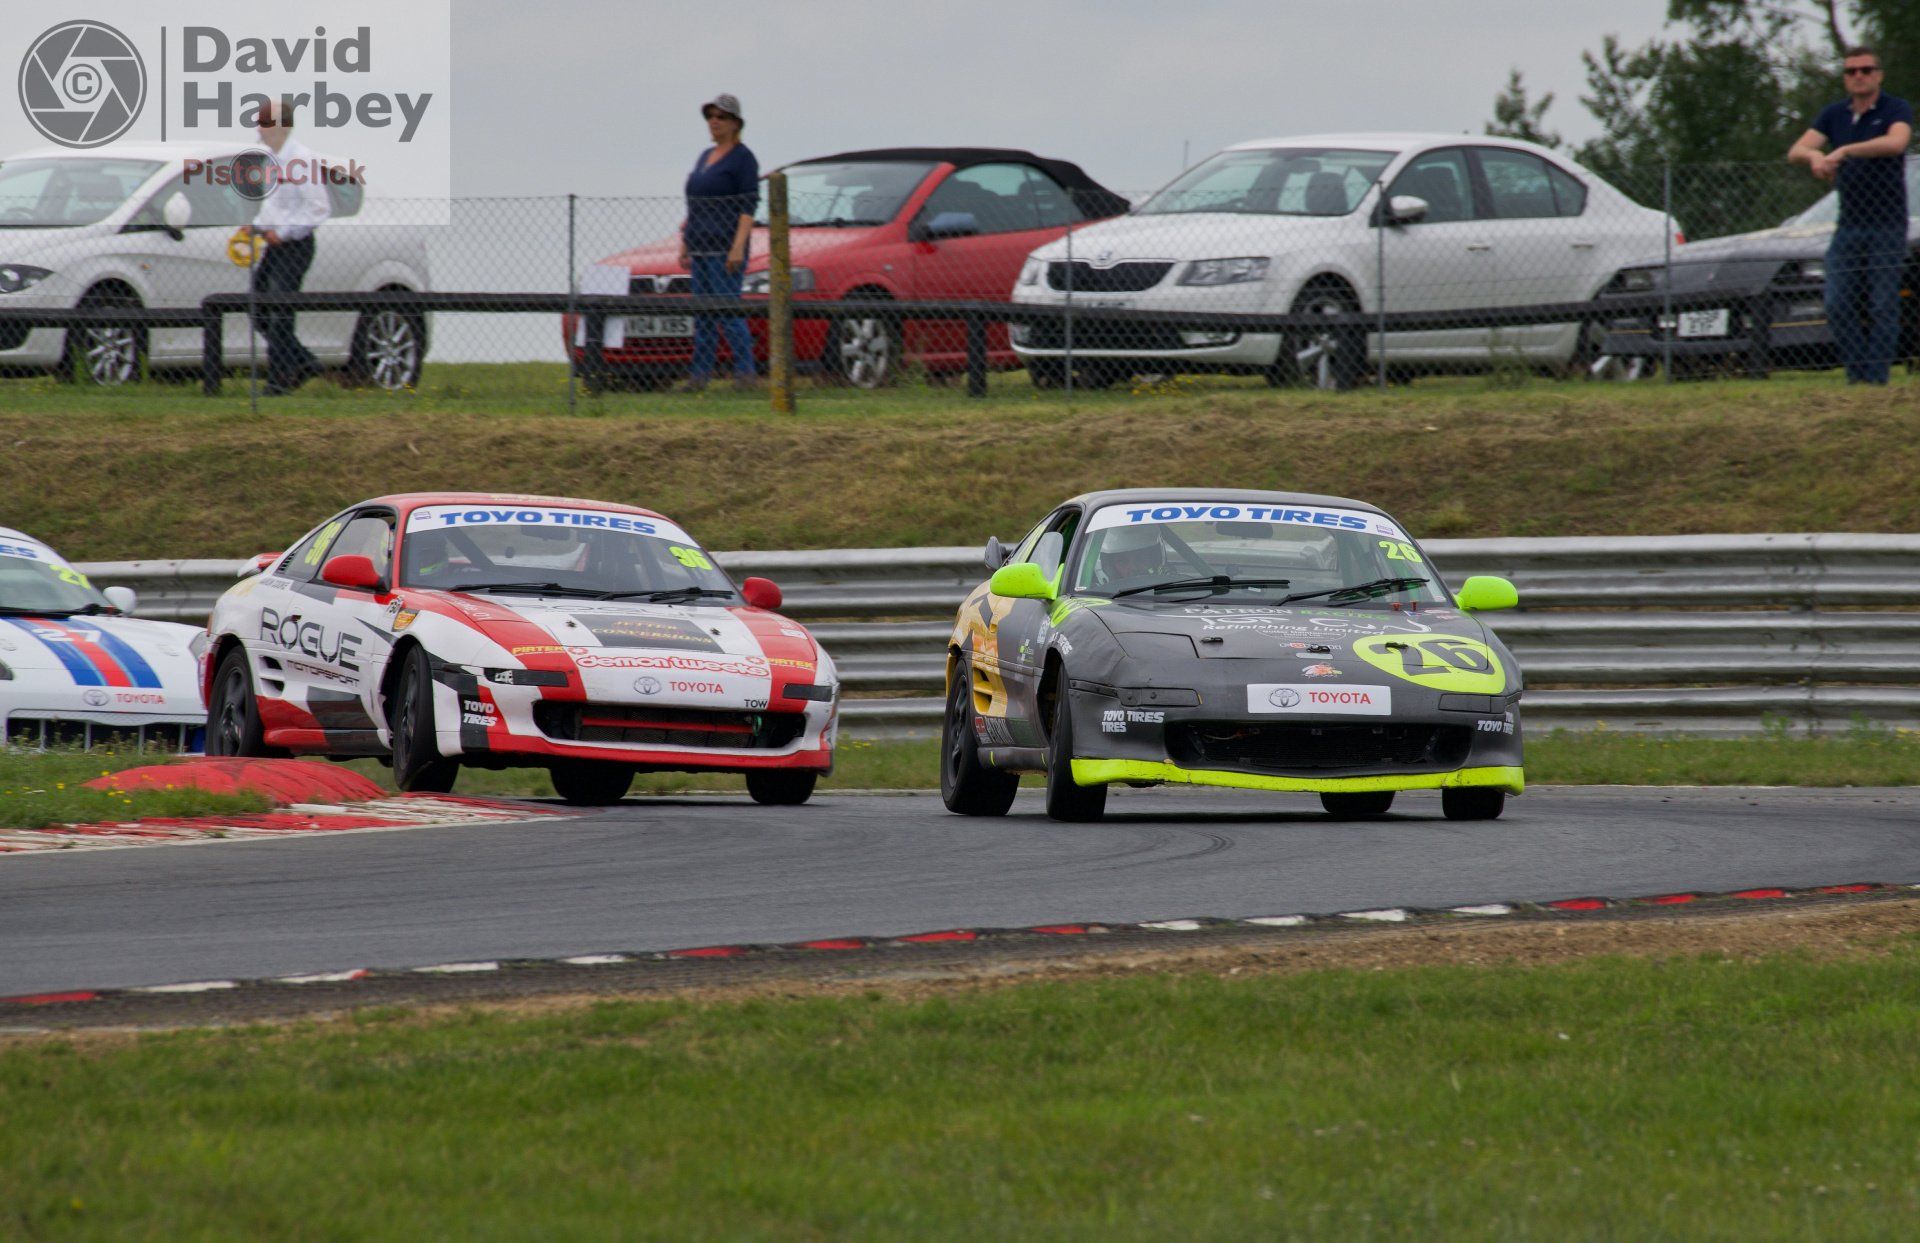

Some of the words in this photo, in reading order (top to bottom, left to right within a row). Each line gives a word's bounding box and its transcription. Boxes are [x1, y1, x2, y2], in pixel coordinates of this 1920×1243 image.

[440, 511, 543, 525] TOYO
[548, 512, 656, 535] TIRES
[1126, 506, 1240, 522] TOYO
[1246, 507, 1368, 530] TIRES
[668, 546, 713, 570] 36
[1379, 541, 1423, 563] 26
[1203, 623, 1307, 632] Refinishing
[1312, 625, 1384, 635] Limited
[260, 607, 362, 672] ROGUE
[1368, 638, 1496, 676] 26
[669, 681, 724, 694] TOYOTA
[114, 693, 165, 704] TOYOTA
[744, 699, 768, 708] TOW
[1309, 691, 1371, 704] TOYOTA
[464, 700, 494, 714] TOYO
[463, 713, 498, 726] TIRES
[1103, 710, 1125, 721] TOYO
[1126, 710, 1165, 723] TIRES
[1101, 721, 1127, 733] TIRES
[1477, 720, 1502, 731] TOYO
